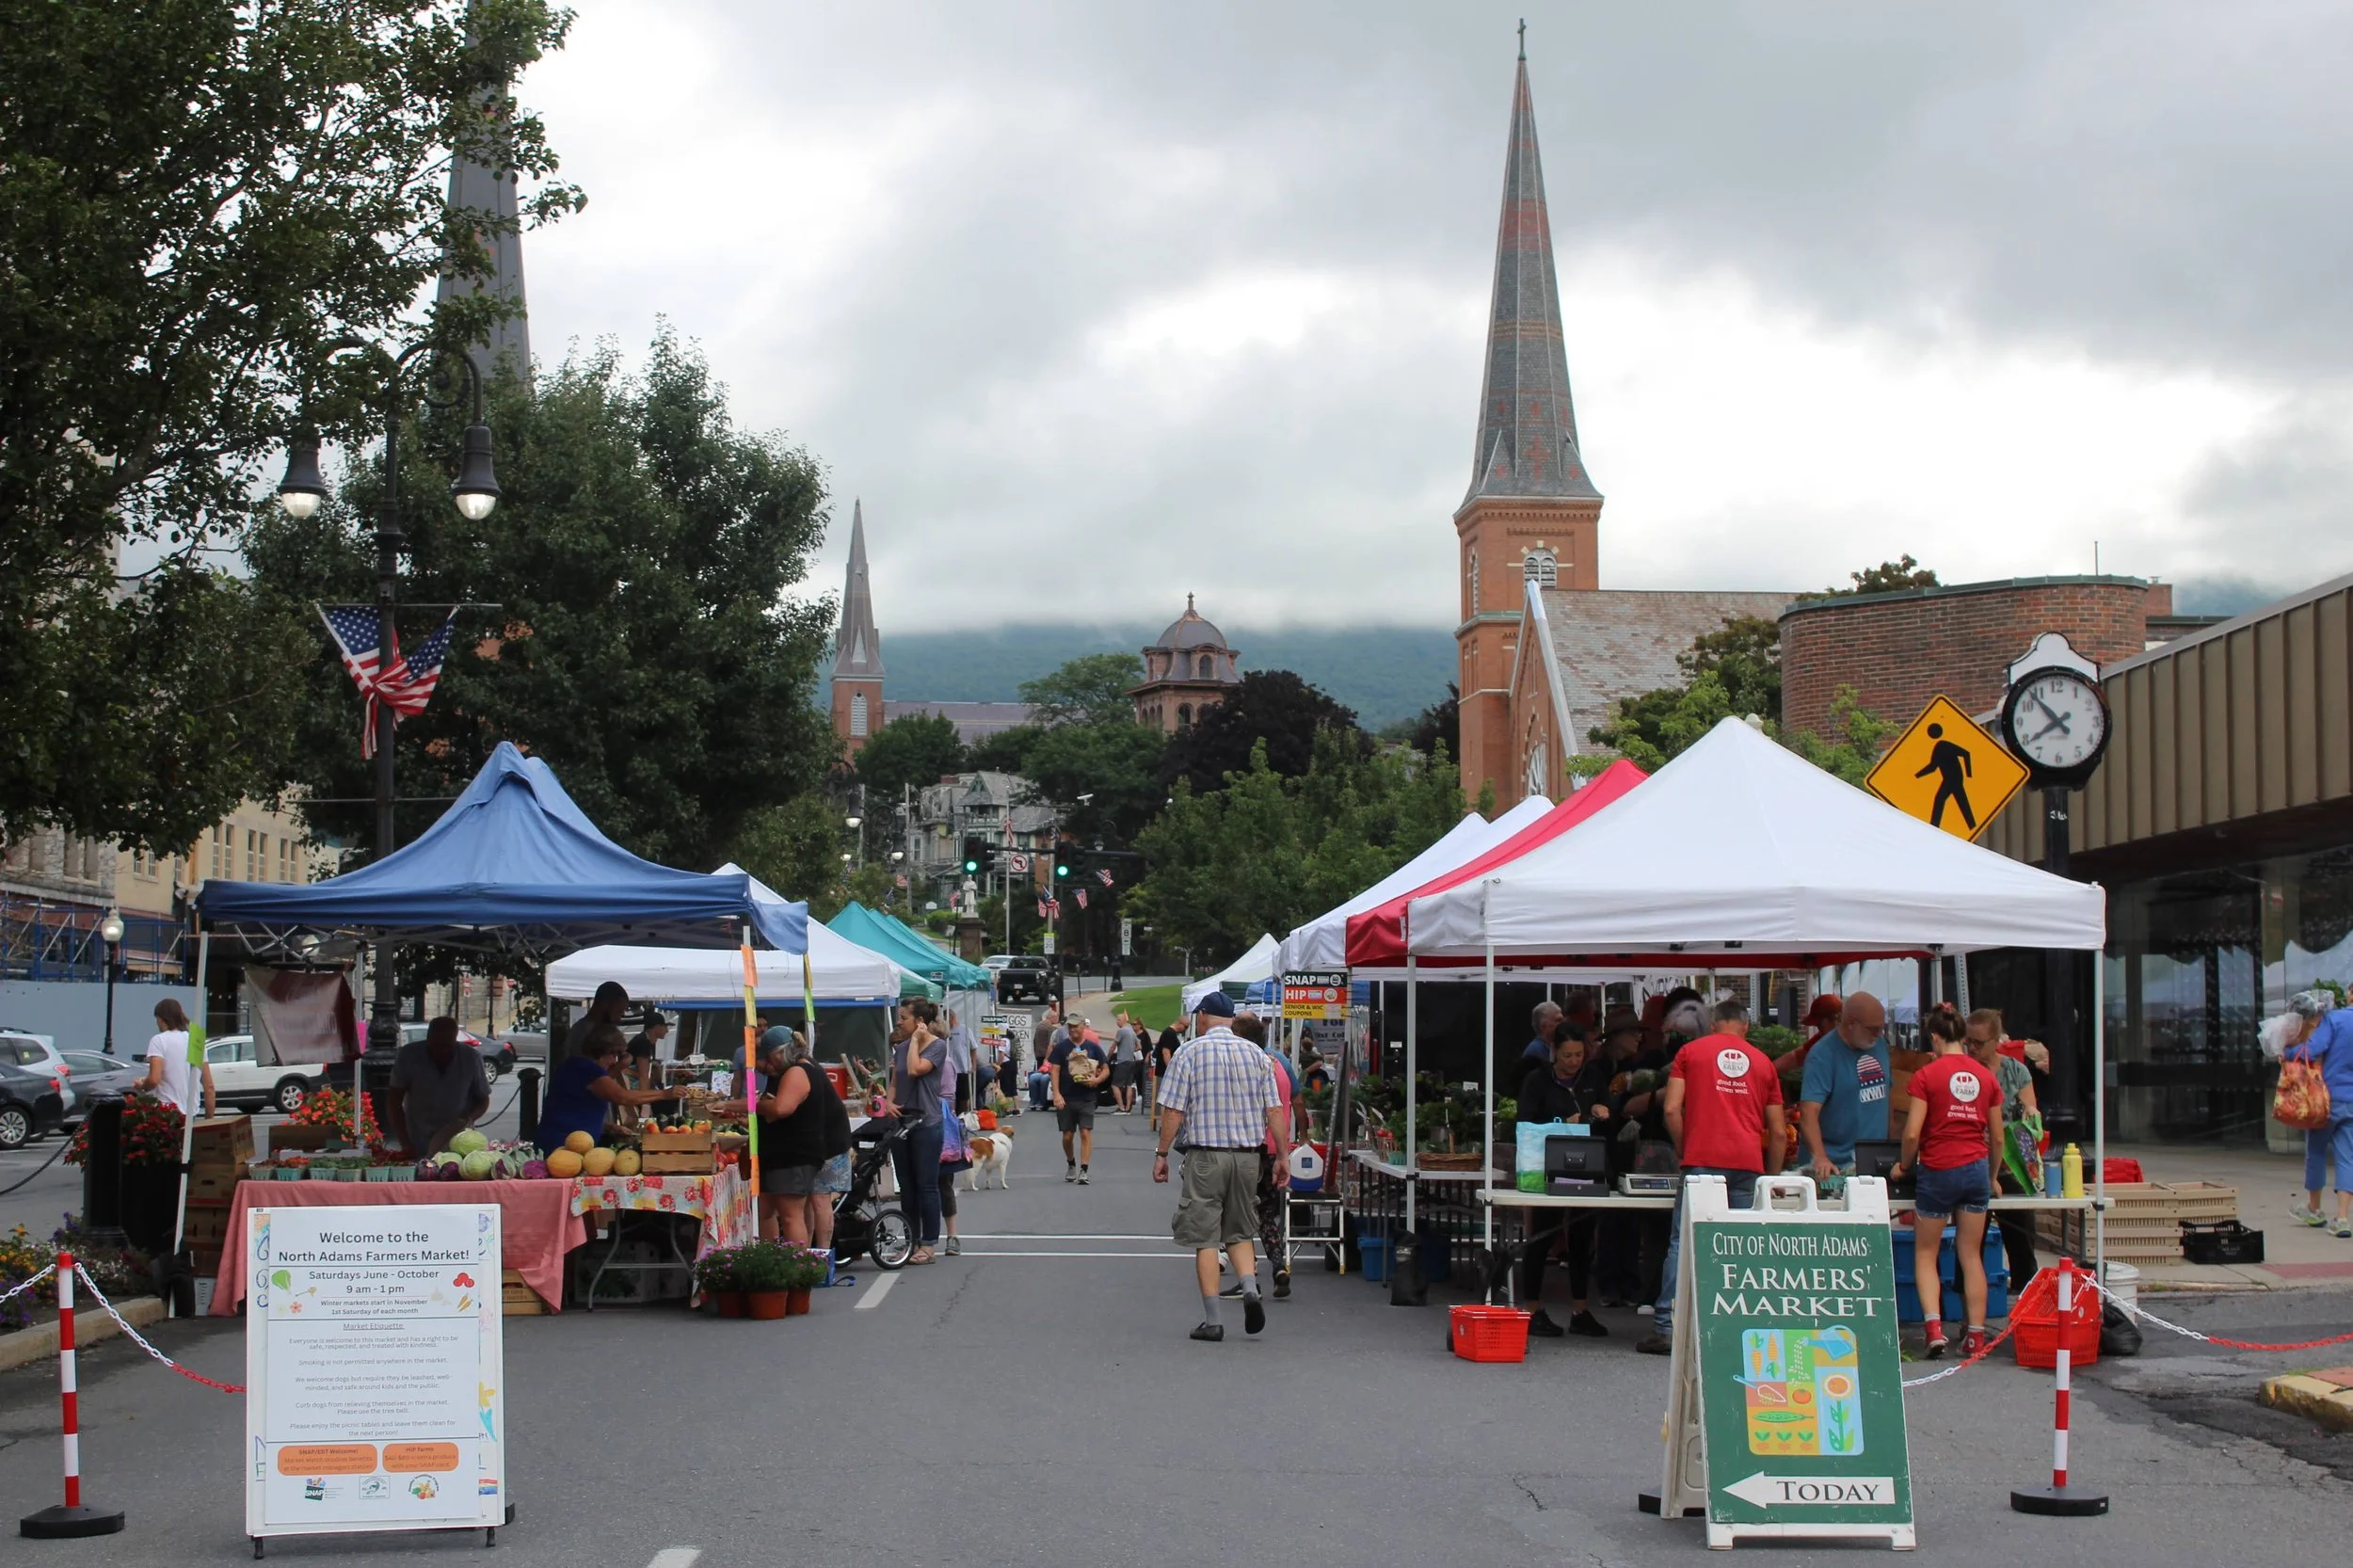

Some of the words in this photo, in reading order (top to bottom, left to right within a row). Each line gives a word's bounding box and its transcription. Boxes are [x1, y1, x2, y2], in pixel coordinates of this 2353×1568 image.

[2051, 680, 2063, 693] 12
[2073, 687, 2078, 698] 1
[2022, 700, 2033, 712] 10
[2086, 699, 2093, 711] 2
[2016, 717, 2024, 728] 9
[2093, 716, 2099, 728] 3
[2022, 734, 2029, 745] 8
[2087, 733, 2093, 745] 4
[2035, 746, 2042, 759] 7
[2056, 752, 2063, 764] 6
[2074, 746, 2082, 759] 5
[1285, 975, 1317, 984] SNAP
[1286, 990, 1306, 1000] HIP
[1008, 1016, 1027, 1026] GGS
[320, 1233, 384, 1243] Welcome
[388, 1233, 402, 1242] to
[406, 1231, 429, 1242] the
[279, 1252, 316, 1261] North
[319, 1252, 361, 1261] Adams
[366, 1251, 418, 1261] Farmers
[422, 1250, 469, 1260] Market!
[309, 1271, 361, 1281] Saturdays
[363, 1271, 389, 1279] June
[397, 1271, 440, 1279] October
[388, 1286, 405, 1295] pm
